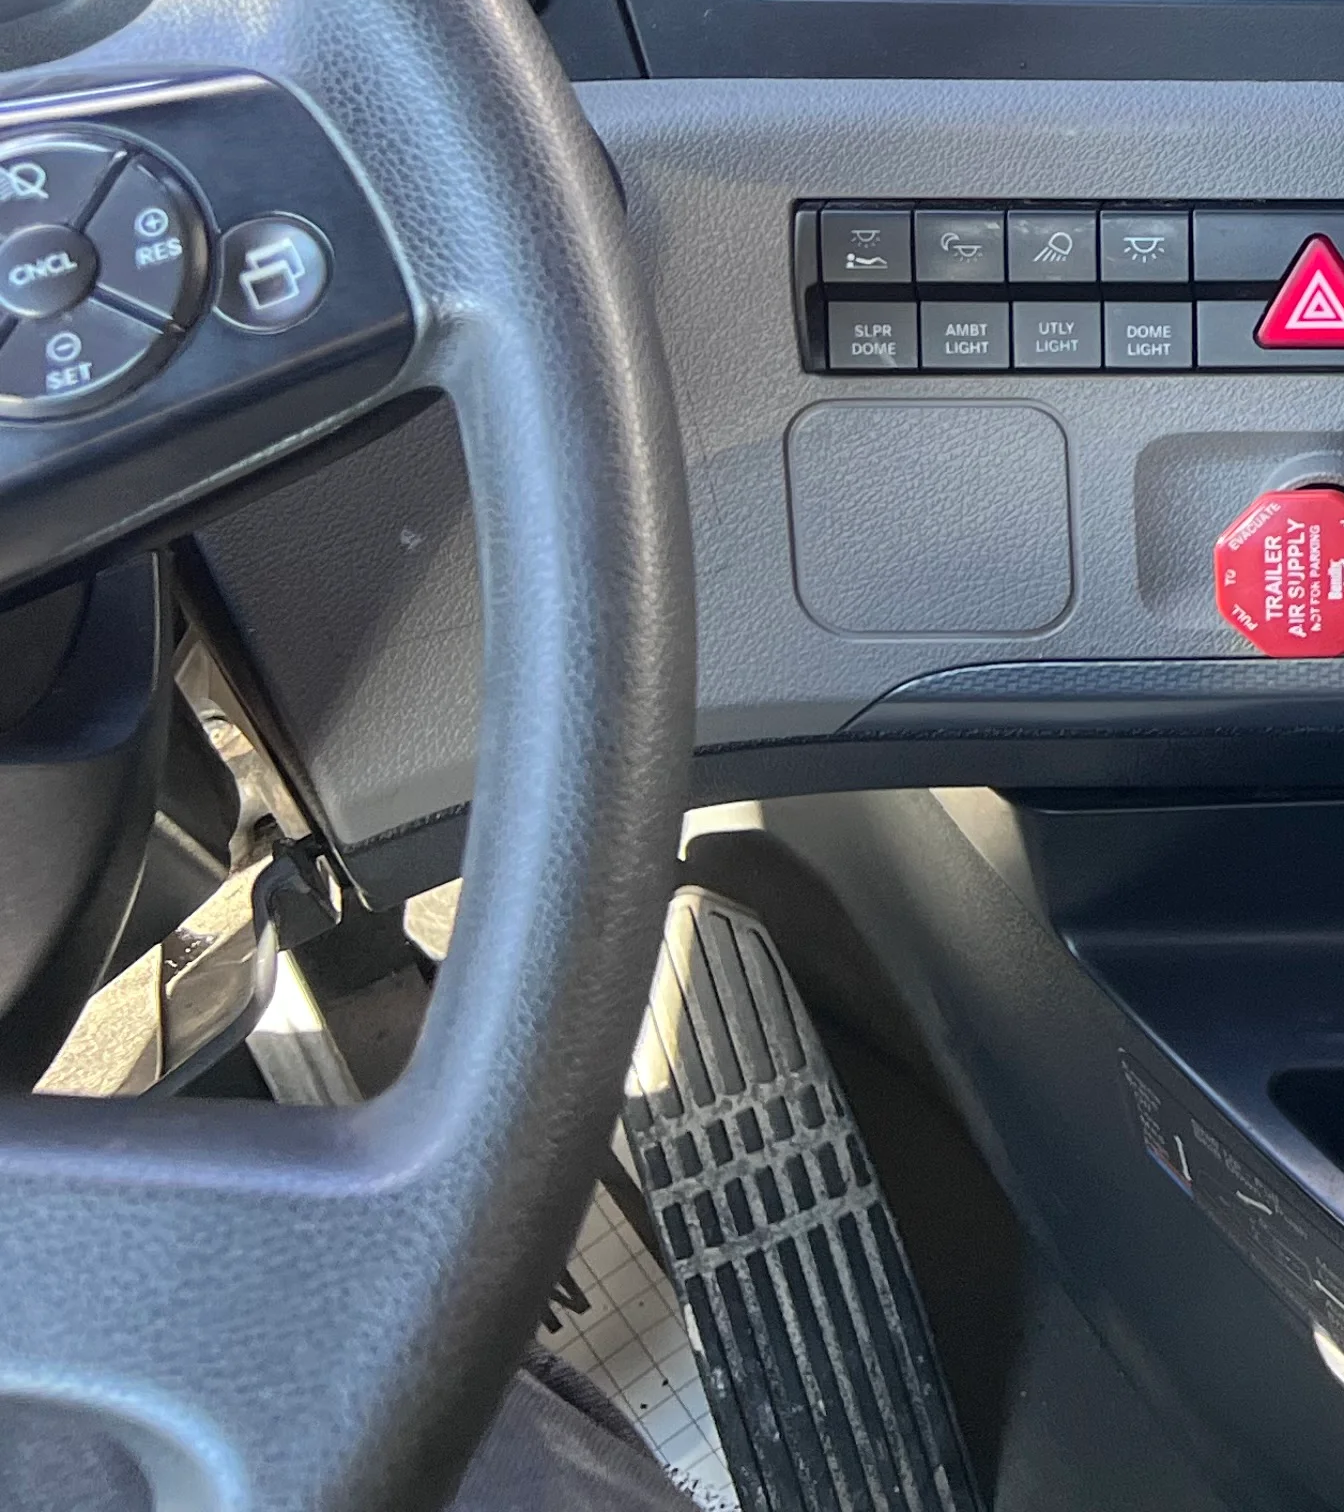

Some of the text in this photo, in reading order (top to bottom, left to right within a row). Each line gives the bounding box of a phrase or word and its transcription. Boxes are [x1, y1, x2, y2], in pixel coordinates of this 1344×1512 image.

[135, 237, 182, 268] RES
[8, 251, 78, 286] CNCL
[854, 324, 892, 338] SLPR
[945, 323, 988, 337] AMBT
[1038, 322, 1075, 336] UTLY
[1126, 325, 1171, 340] DOME
[851, 342, 896, 356] DOME
[945, 340, 989, 355] LIGHT
[1036, 340, 1079, 354] LIGHT
[1126, 342, 1171, 356] LIGHT
[46, 361, 93, 390] SET
[1309, 524, 1321, 578] PARKING
[1224, 502, 1282, 631] PULL TO EVACUATE
[1264, 535, 1284, 622] TRAILER
[1287, 518, 1308, 638] AIR SUPPLY
